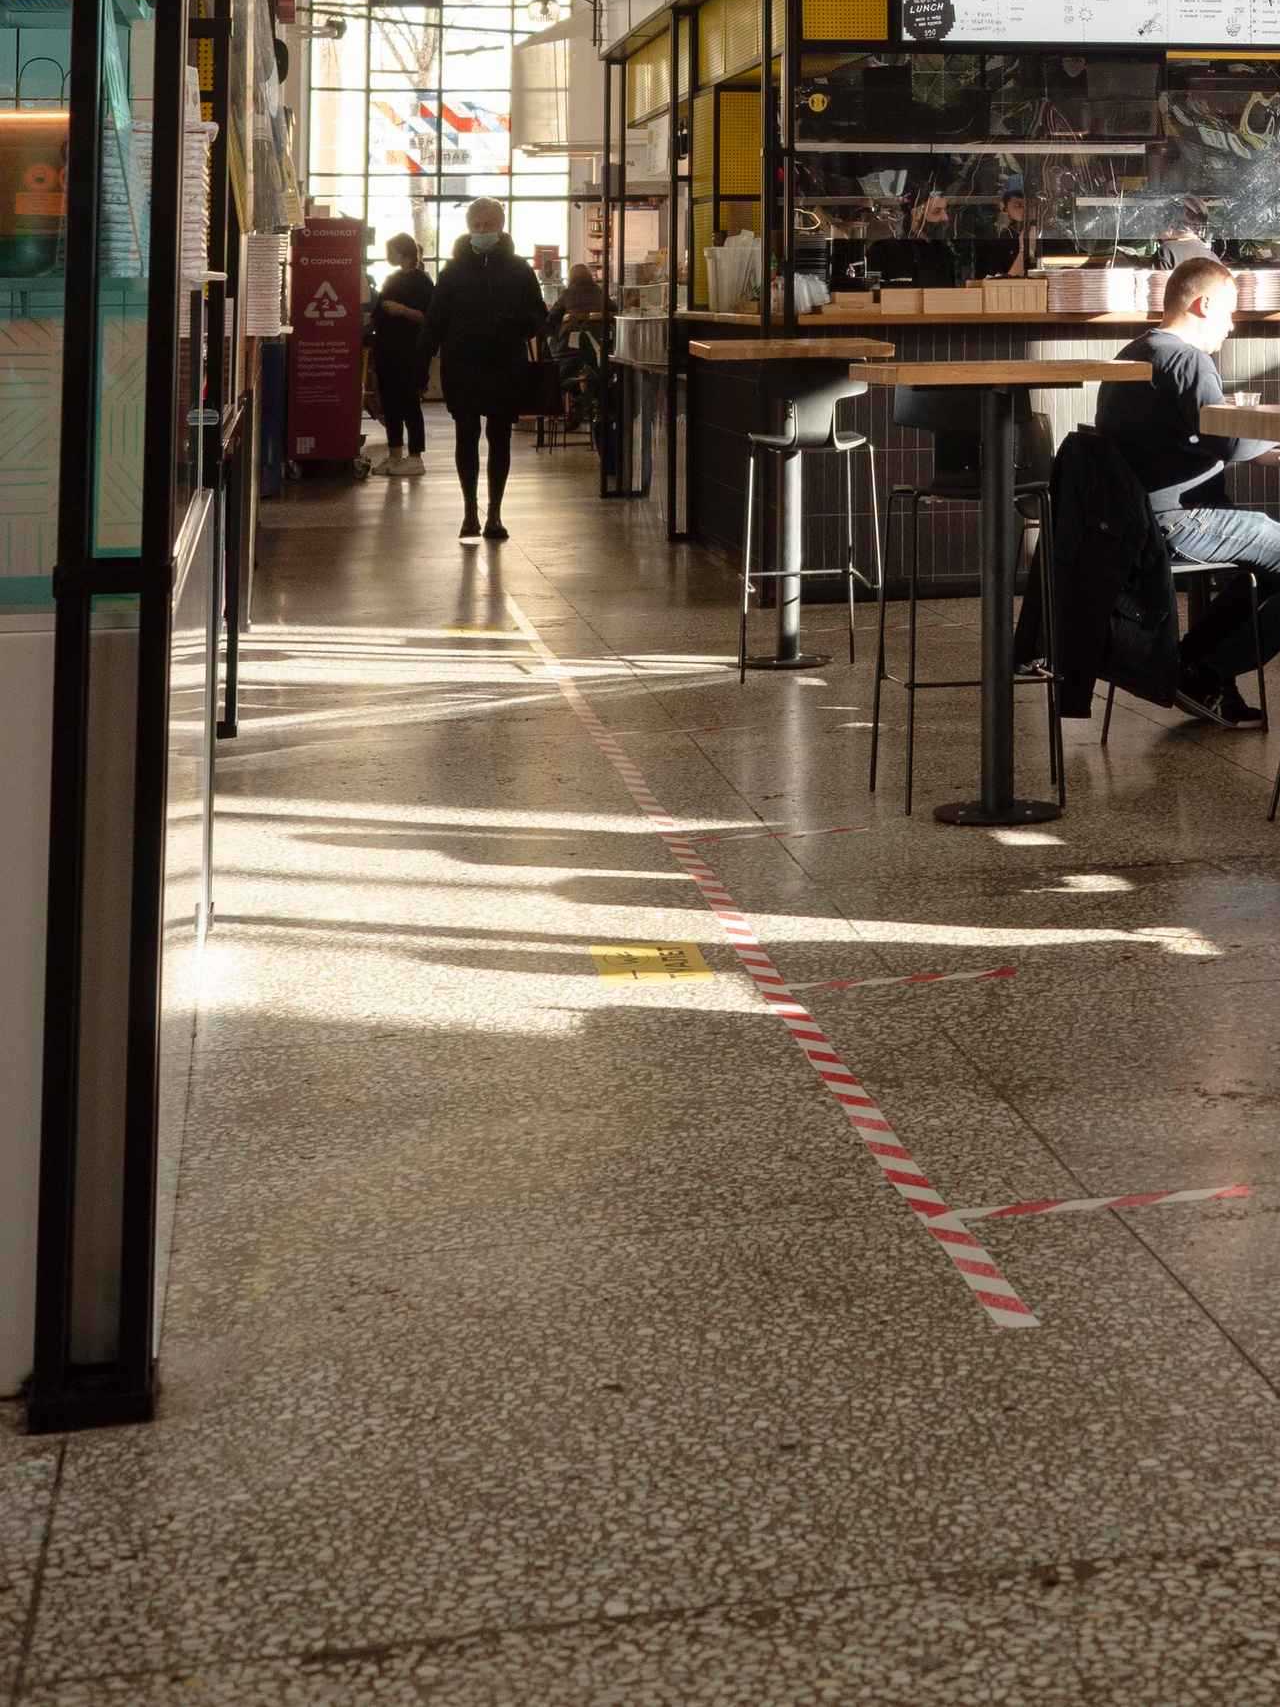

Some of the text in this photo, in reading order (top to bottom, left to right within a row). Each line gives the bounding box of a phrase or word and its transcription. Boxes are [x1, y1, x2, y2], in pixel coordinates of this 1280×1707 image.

[909, 2, 944, 14] LUNCH
[322, 298, 330, 309] 2
[656, 946, 696, 979] ТУАЛЕТ
